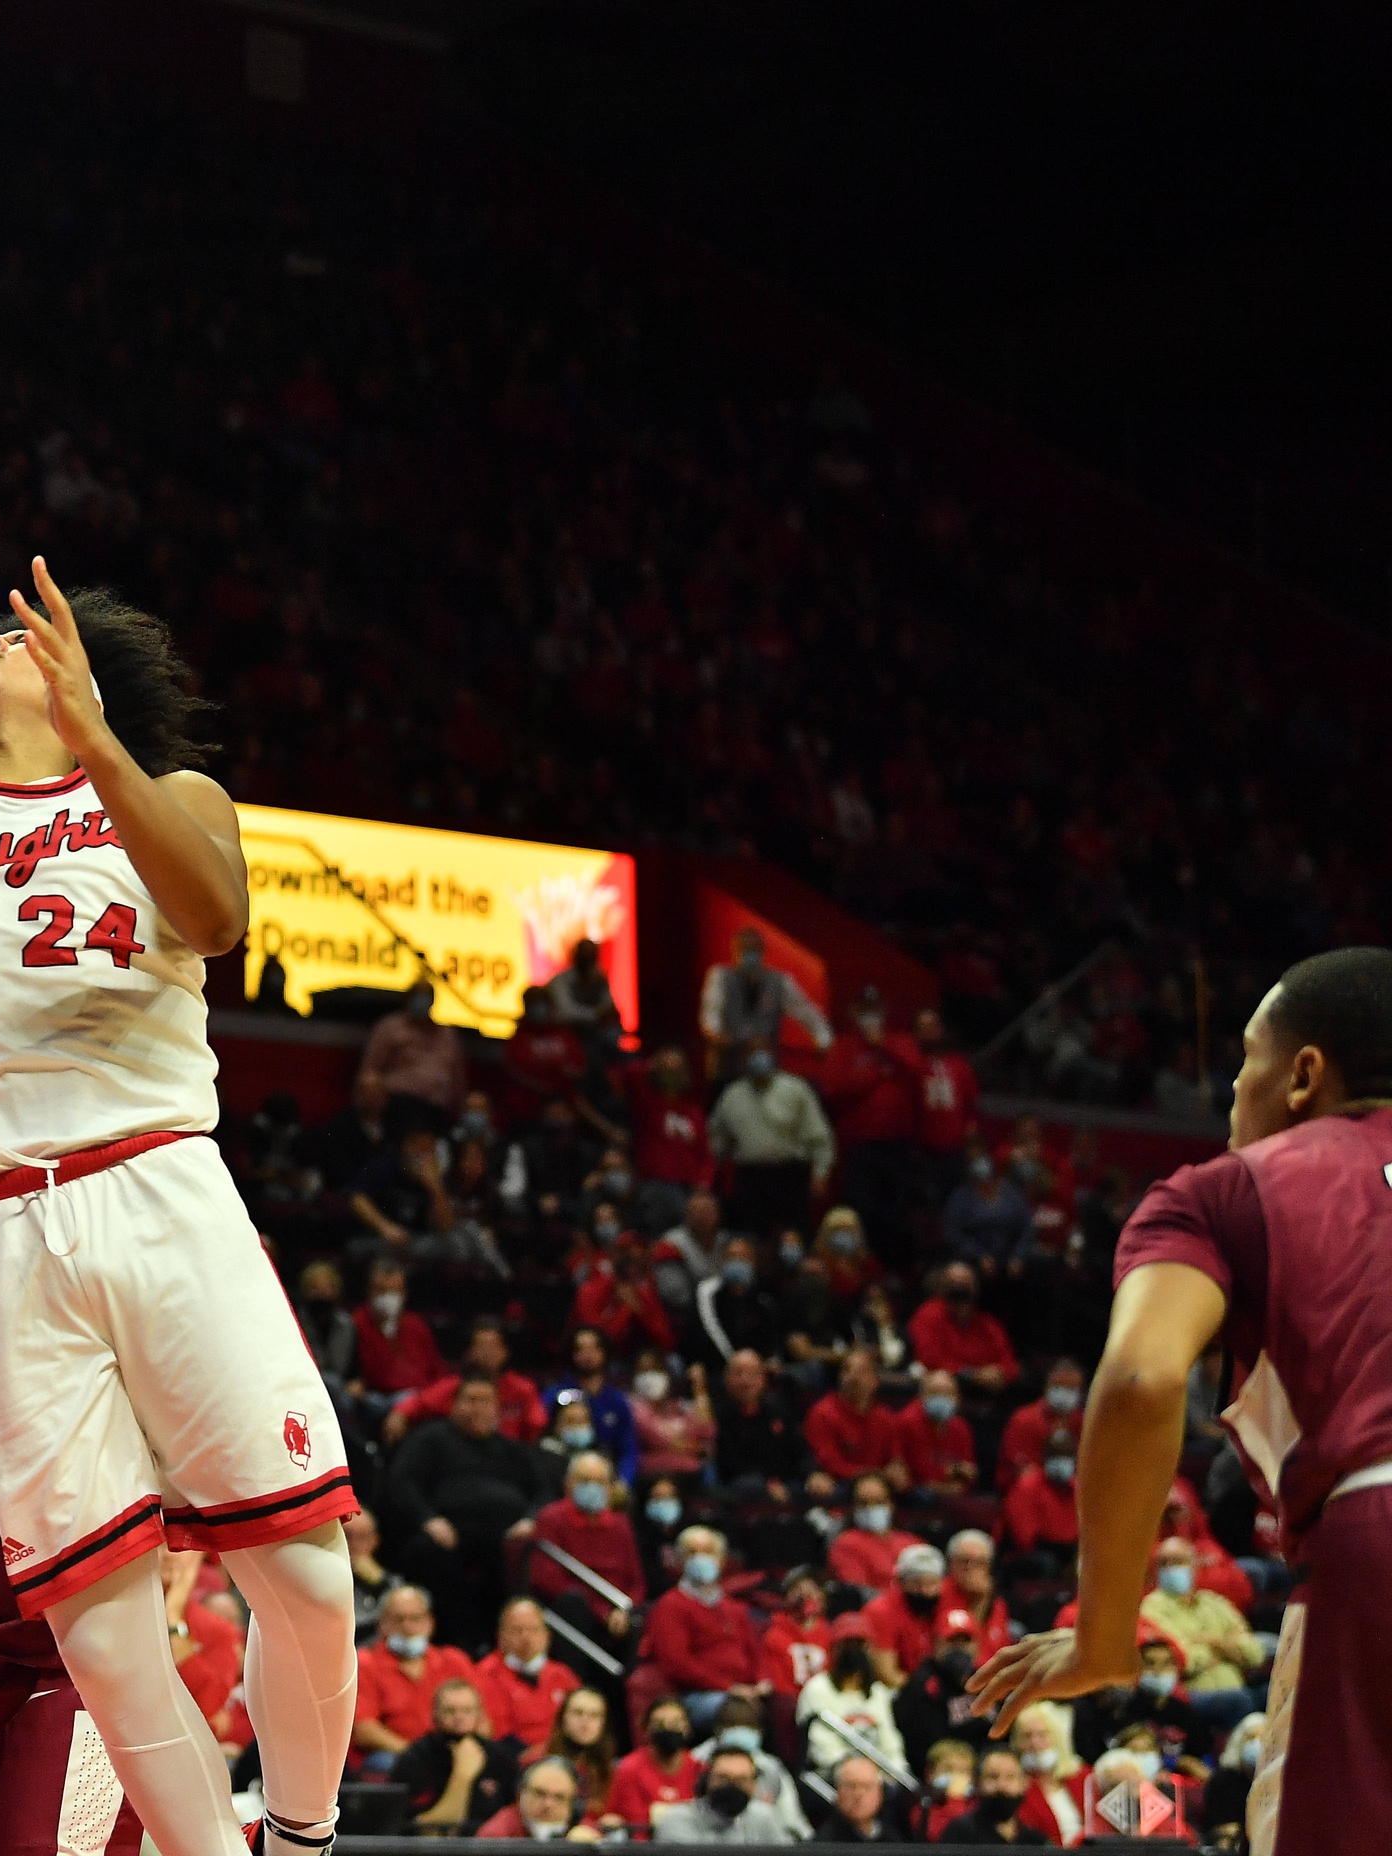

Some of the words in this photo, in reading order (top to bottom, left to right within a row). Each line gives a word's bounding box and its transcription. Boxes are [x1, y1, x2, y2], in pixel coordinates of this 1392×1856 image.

[249, 863, 417, 910] ownload
[430, 876, 492, 915] the
[18, 894, 146, 970] 24
[440, 948, 513, 992] app
